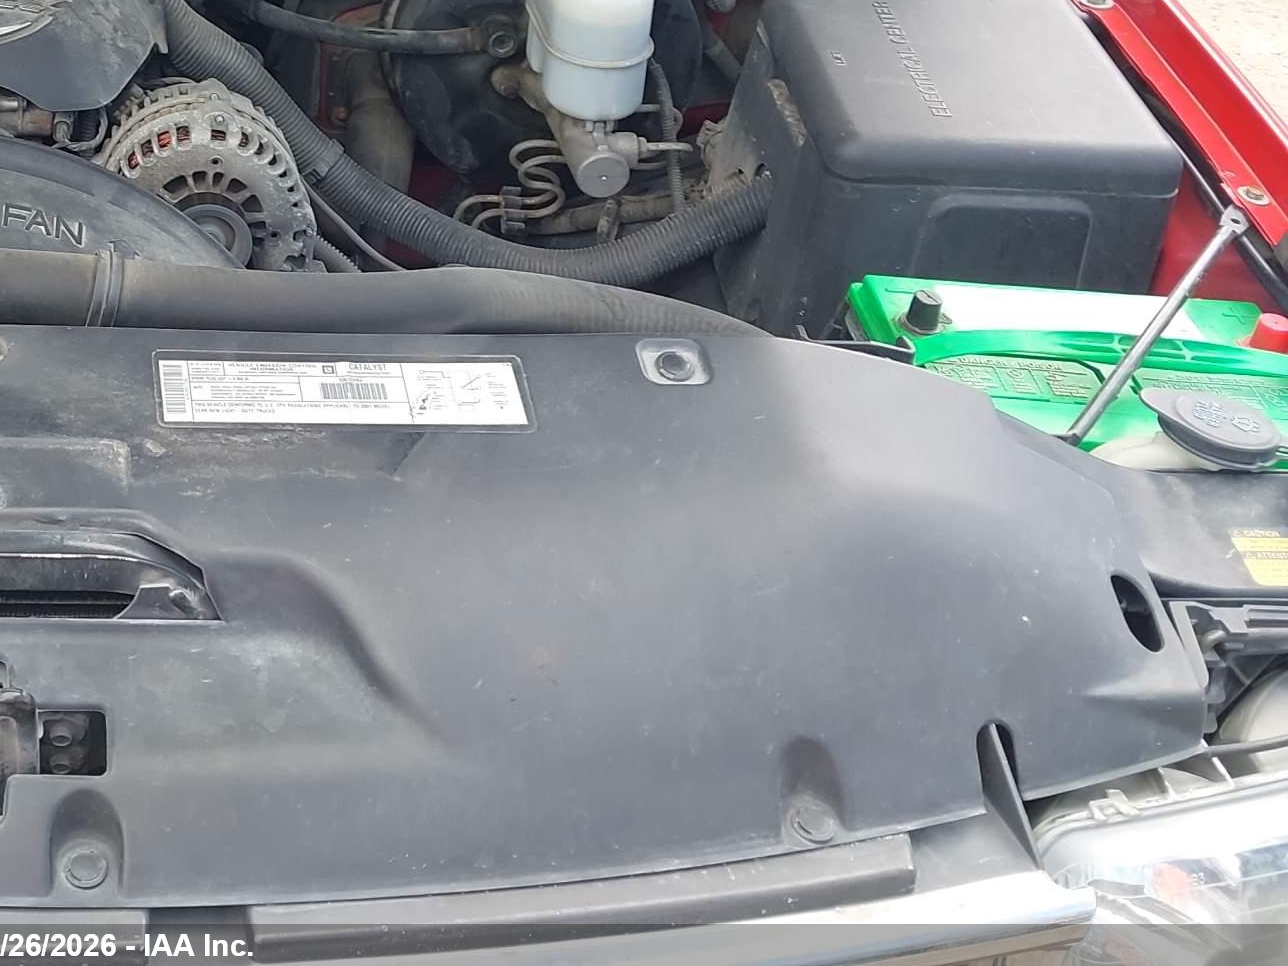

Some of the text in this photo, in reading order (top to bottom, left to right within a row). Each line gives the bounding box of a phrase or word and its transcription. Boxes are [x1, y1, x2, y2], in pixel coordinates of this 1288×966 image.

[872, 0, 953, 118] ELECTRICAL CENTER
[1, 201, 87, 247] FAN
[348, 363, 386, 371] CATALYST
